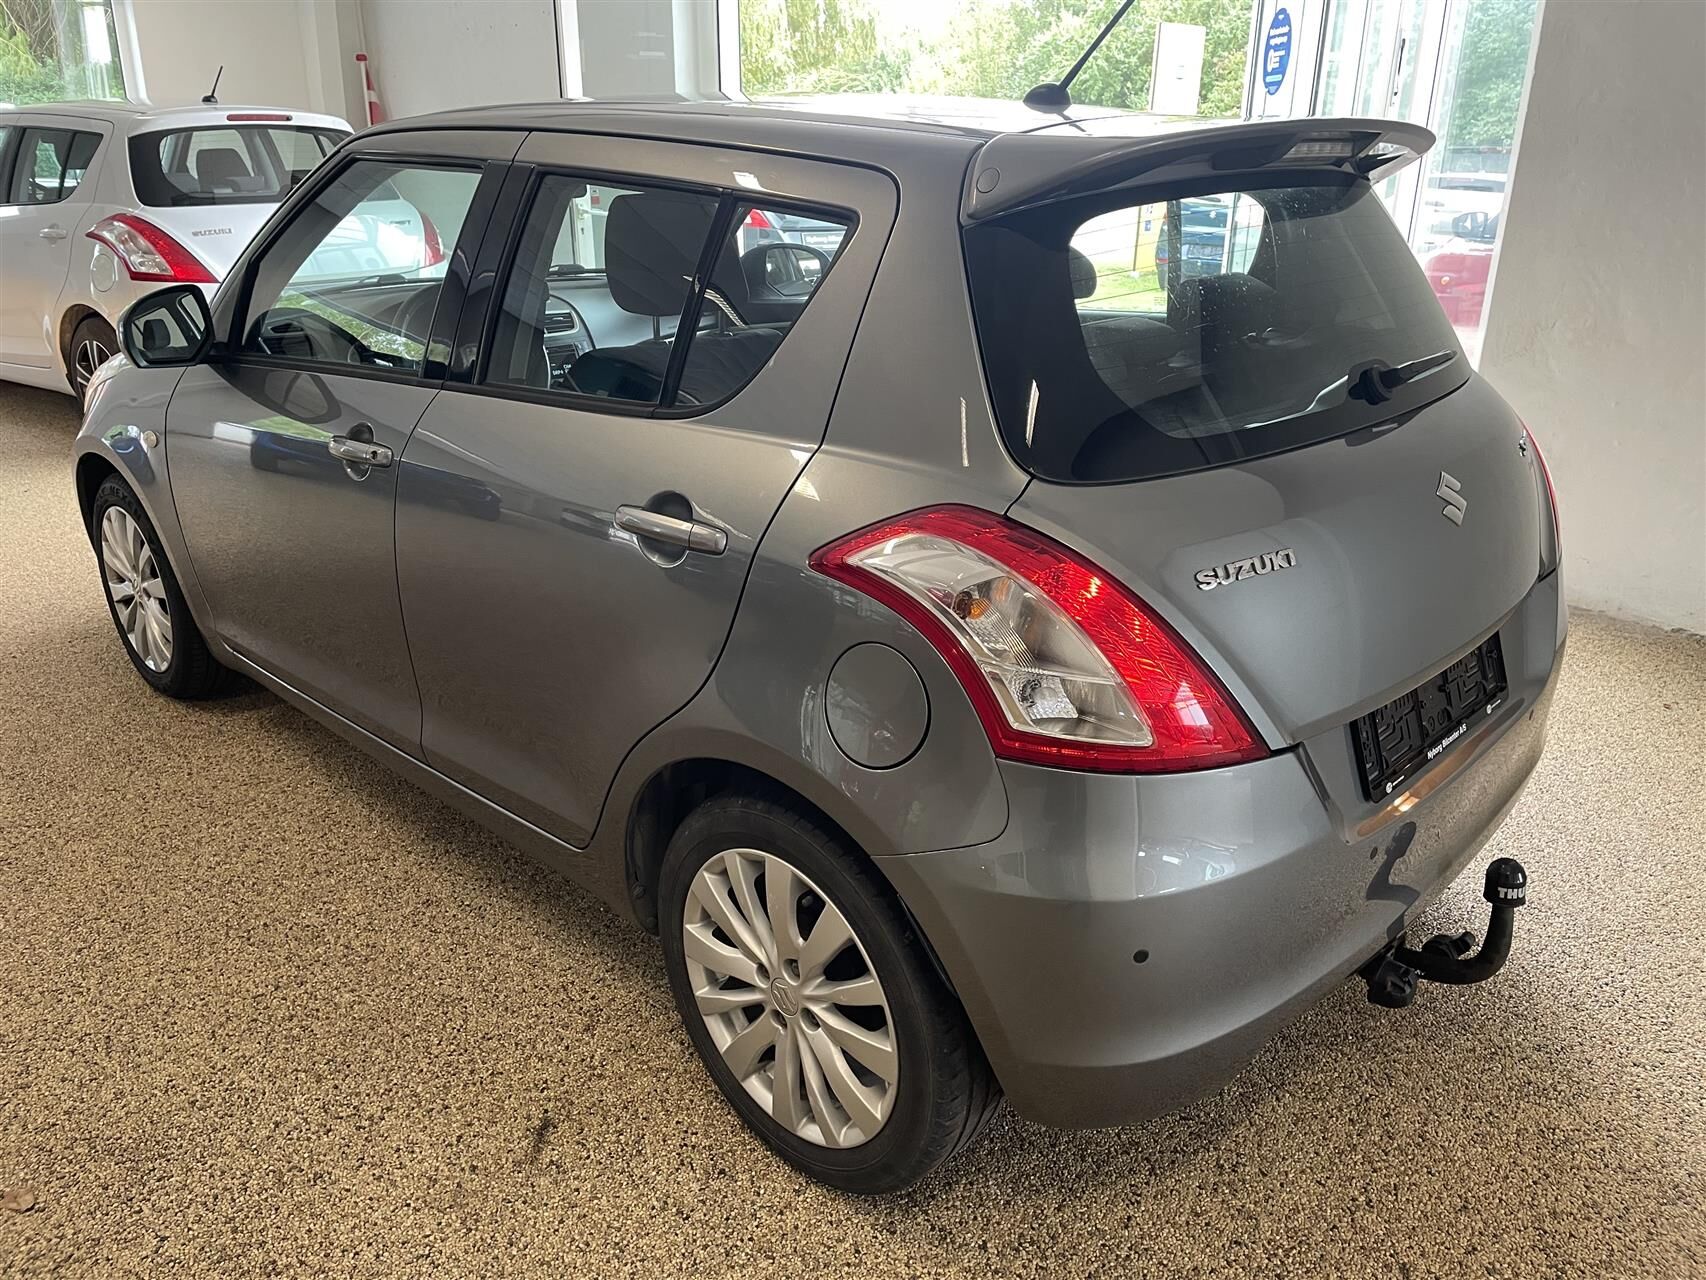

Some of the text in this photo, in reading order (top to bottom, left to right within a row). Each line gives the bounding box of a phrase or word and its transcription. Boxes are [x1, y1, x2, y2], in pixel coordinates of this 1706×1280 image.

[1195, 548, 1297, 591] SUZUKI
[1427, 744, 1442, 759] Nyborg
[1498, 887, 1525, 899] THU
